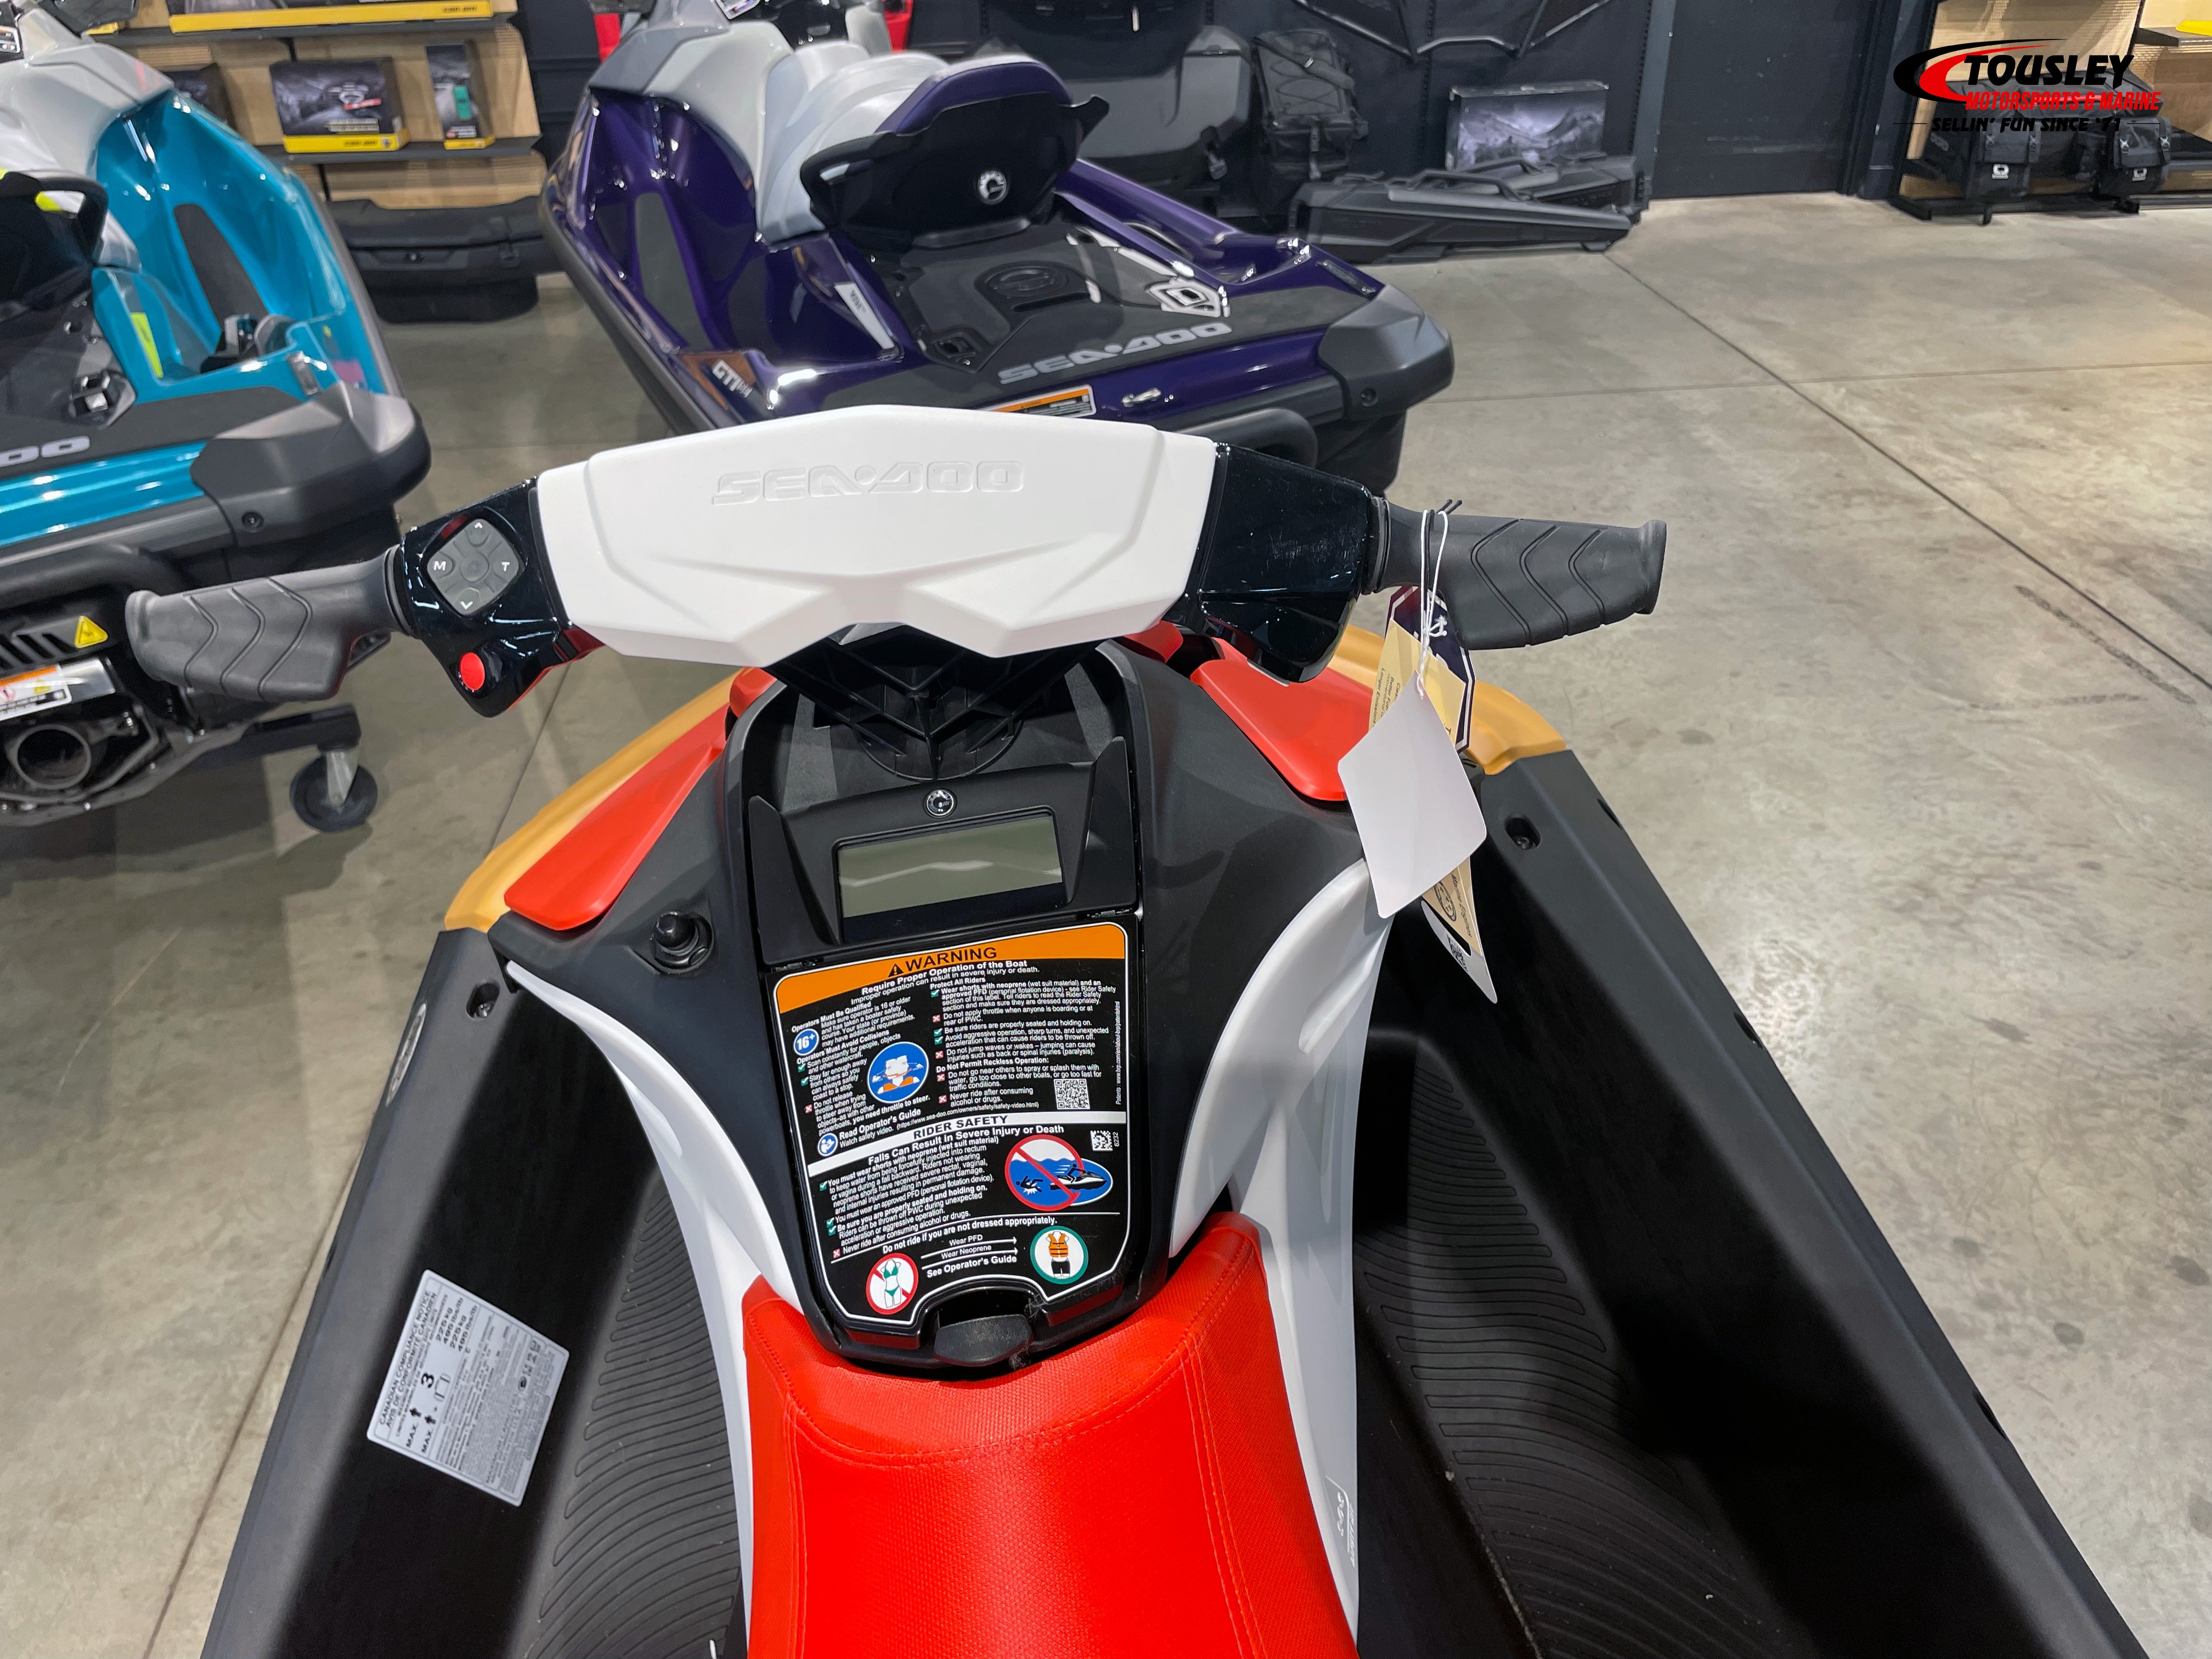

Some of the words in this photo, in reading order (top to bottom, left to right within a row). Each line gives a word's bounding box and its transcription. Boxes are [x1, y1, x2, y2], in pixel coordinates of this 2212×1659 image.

[433, 560, 447, 571] M
[501, 561, 511, 572] T
[905, 946, 996, 971] WARNING
[851, 991, 881, 1005] Improper
[882, 981, 915, 995] operation
[930, 973, 950, 983] result
[861, 980, 895, 995] Require
[896, 972, 927, 984] Proper
[928, 964, 974, 977] Operation
[929, 980, 953, 990] Protect
[791, 1019, 819, 1032] Operators
[820, 1013, 834, 1023] Must
[844, 1000, 871, 1014] Qualified
[821, 1019, 836, 1029] Make
[837, 1015, 849, 1023] sure
[850, 1007, 873, 1019] operator
[881, 1001, 888, 1009] 16
[895, 996, 910, 1005] older
[797, 1051, 825, 1064] Operators
[826, 1045, 840, 1054] Must
[841, 1038, 858, 1049] Avoid
[859, 1030, 889, 1043] Collisions
[945, 1033, 962, 1042] Avoid
[963, 1030, 996, 1040] aggressive
[960, 1060, 982, 1068] Permit
[950, 1098, 973, 1107] alcohol
[839, 1126, 857, 1140] Read
[898, 1109, 921, 1120] Guide
[913, 1122, 951, 1139] RIDER
[956, 1115, 1008, 1129] SAFETY
[839, 1136, 857, 1148] Watch
[858, 1132, 875, 1142] safety
[868, 1152, 889, 1165] Falls
[891, 1147, 910, 1158] Can
[912, 1137, 941, 1152] Result
[944, 1135, 953, 1143] in
[955, 1130, 990, 1141] Severe
[992, 1127, 1020, 1136] Injury
[827, 1178, 839, 1187] You
[840, 1172, 855, 1182] must
[856, 1167, 871, 1177] wear
[872, 1161, 891, 1172] shorts
[893, 1155, 906, 1165] with
[907, 1148, 937, 1161] neoprene
[938, 1143, 952, 1154] (wet
[954, 1140, 967, 1149] suit
[846, 1220, 860, 1228] sure
[860, 1216, 872, 1226] you
[884, 1203, 910, 1218] properly
[912, 1195, 933, 1208] seated
[934, 1192, 947, 1201] and
[948, 1187, 974, 1198] holding
[882, 1245, 893, 1254] Do
[894, 1240, 905, 1251] not
[906, 1236, 921, 1246] ride
[922, 1233, 927, 1242] if
[928, 1231, 942, 1242] you
[944, 1227, 955, 1235] are
[957, 1222, 970, 1232] not
[971, 1218, 1003, 1229] dressed
[1005, 1216, 1057, 1227] appropriately.
[949, 1238, 966, 1247] Wear
[968, 1234, 983, 1242] PFD
[941, 1251, 958, 1260] Wear
[959, 1245, 992, 1255] Neoprene
[927, 1268, 942, 1278] See
[991, 1254, 1017, 1263] Guide
[421, 1373, 435, 1389] 3
